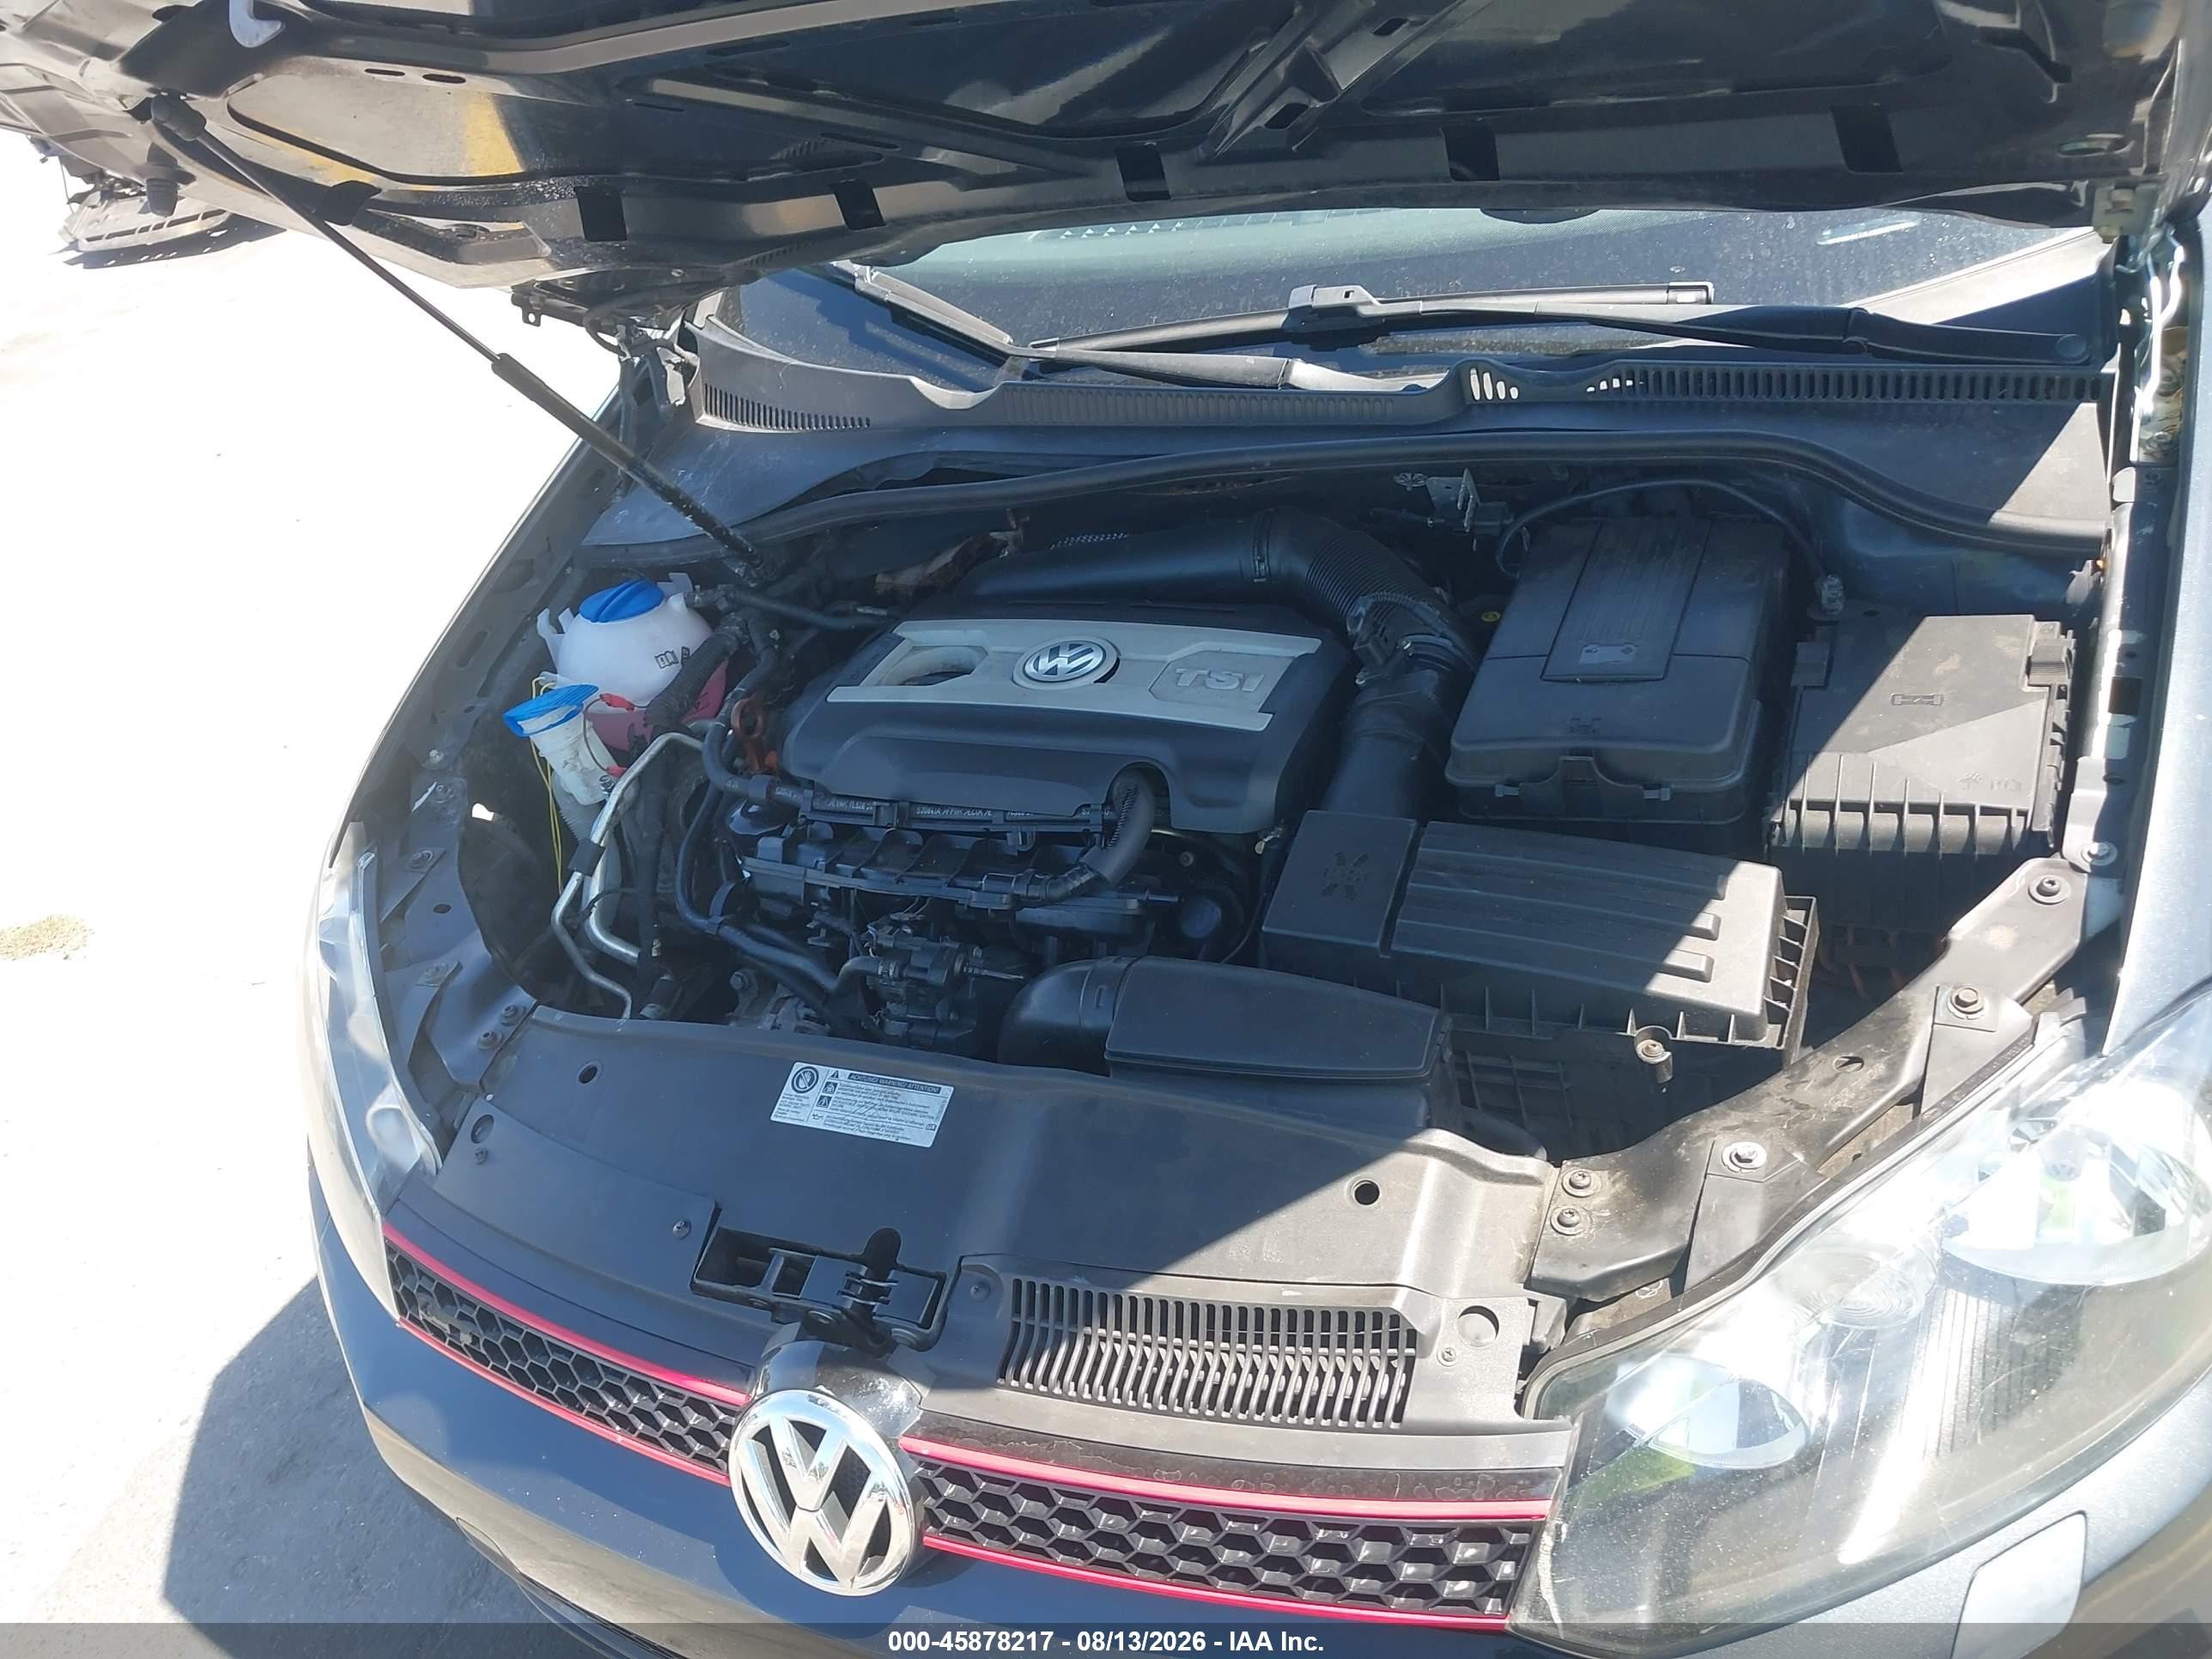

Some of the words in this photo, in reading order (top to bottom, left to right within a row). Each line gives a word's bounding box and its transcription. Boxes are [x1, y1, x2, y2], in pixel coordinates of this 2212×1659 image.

[1174, 667, 1265, 693] TSI
[849, 1073, 879, 1085] ACHTUNG!
[879, 1078, 908, 1088] WARNING!
[907, 1082, 940, 1093] ATTENTION!
